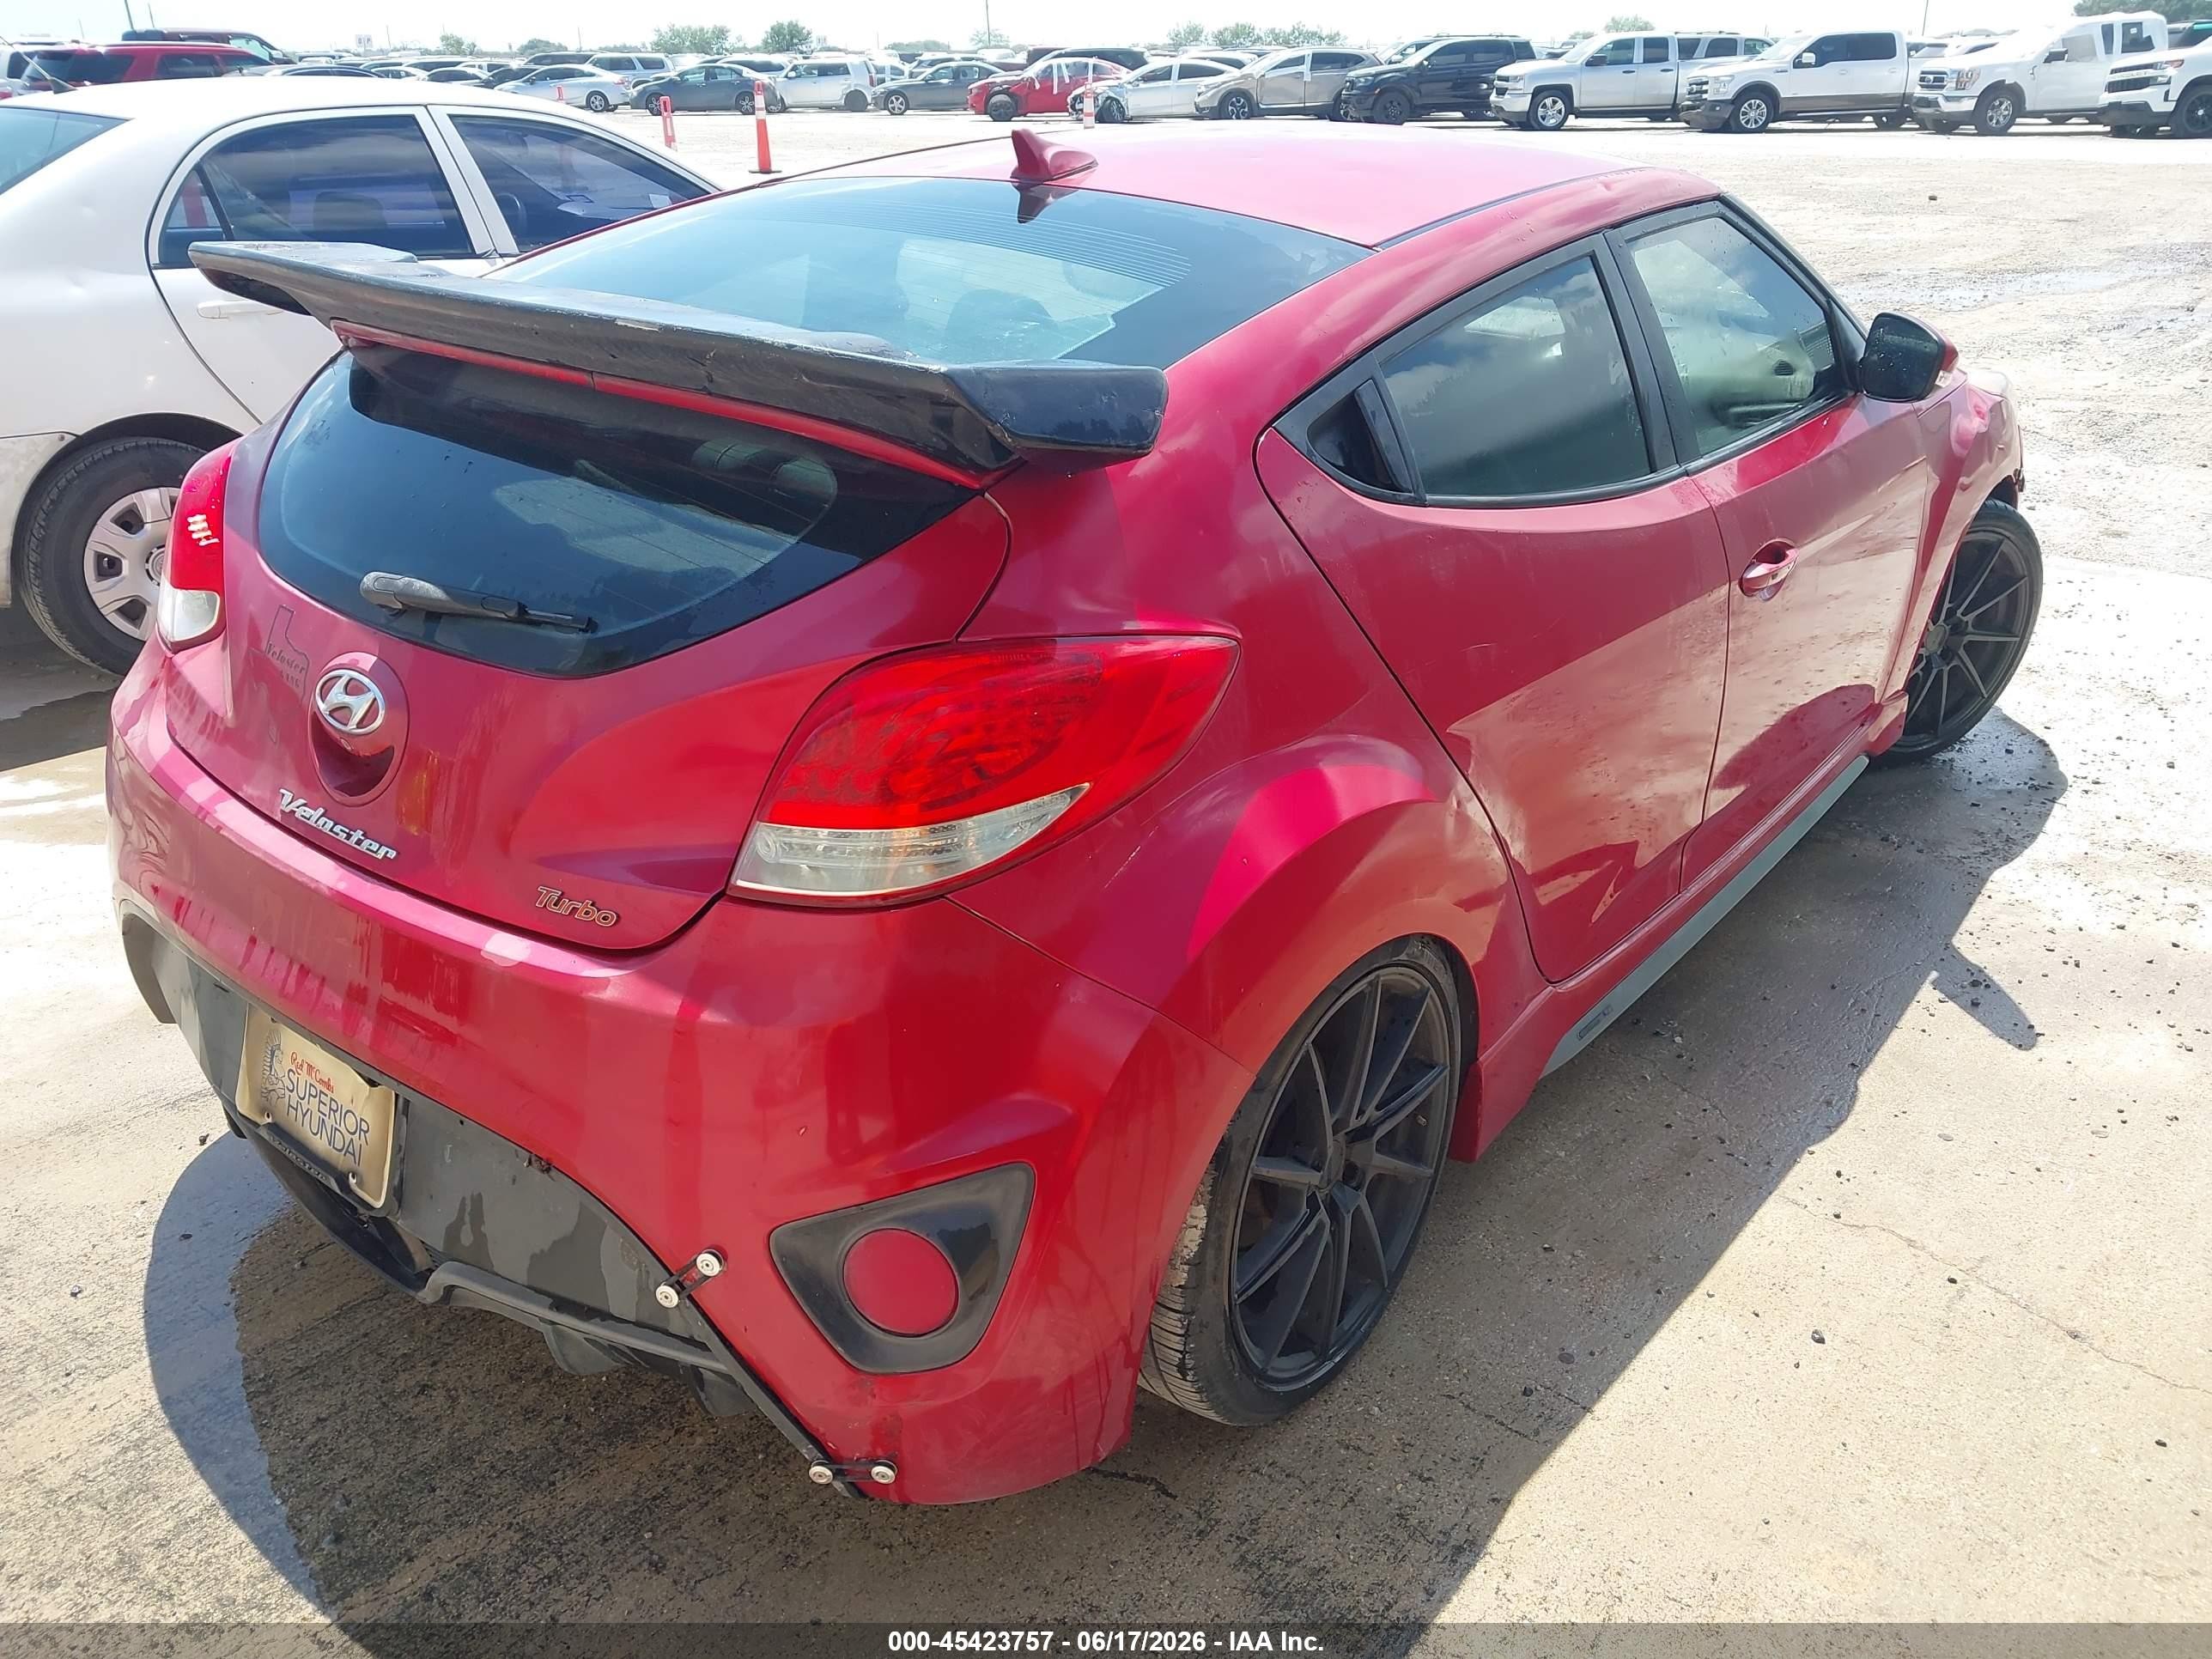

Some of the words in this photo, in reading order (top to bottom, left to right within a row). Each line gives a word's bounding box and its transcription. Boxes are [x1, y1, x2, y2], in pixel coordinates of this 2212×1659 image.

[267, 643, 306, 674] Veloster
[279, 788, 397, 861] Veloster
[536, 885, 617, 927] Turbo
[290, 1051, 305, 1075] Red
[286, 1068, 370, 1146] SUPERIOR
[287, 1097, 362, 1167] HYUNDAI
